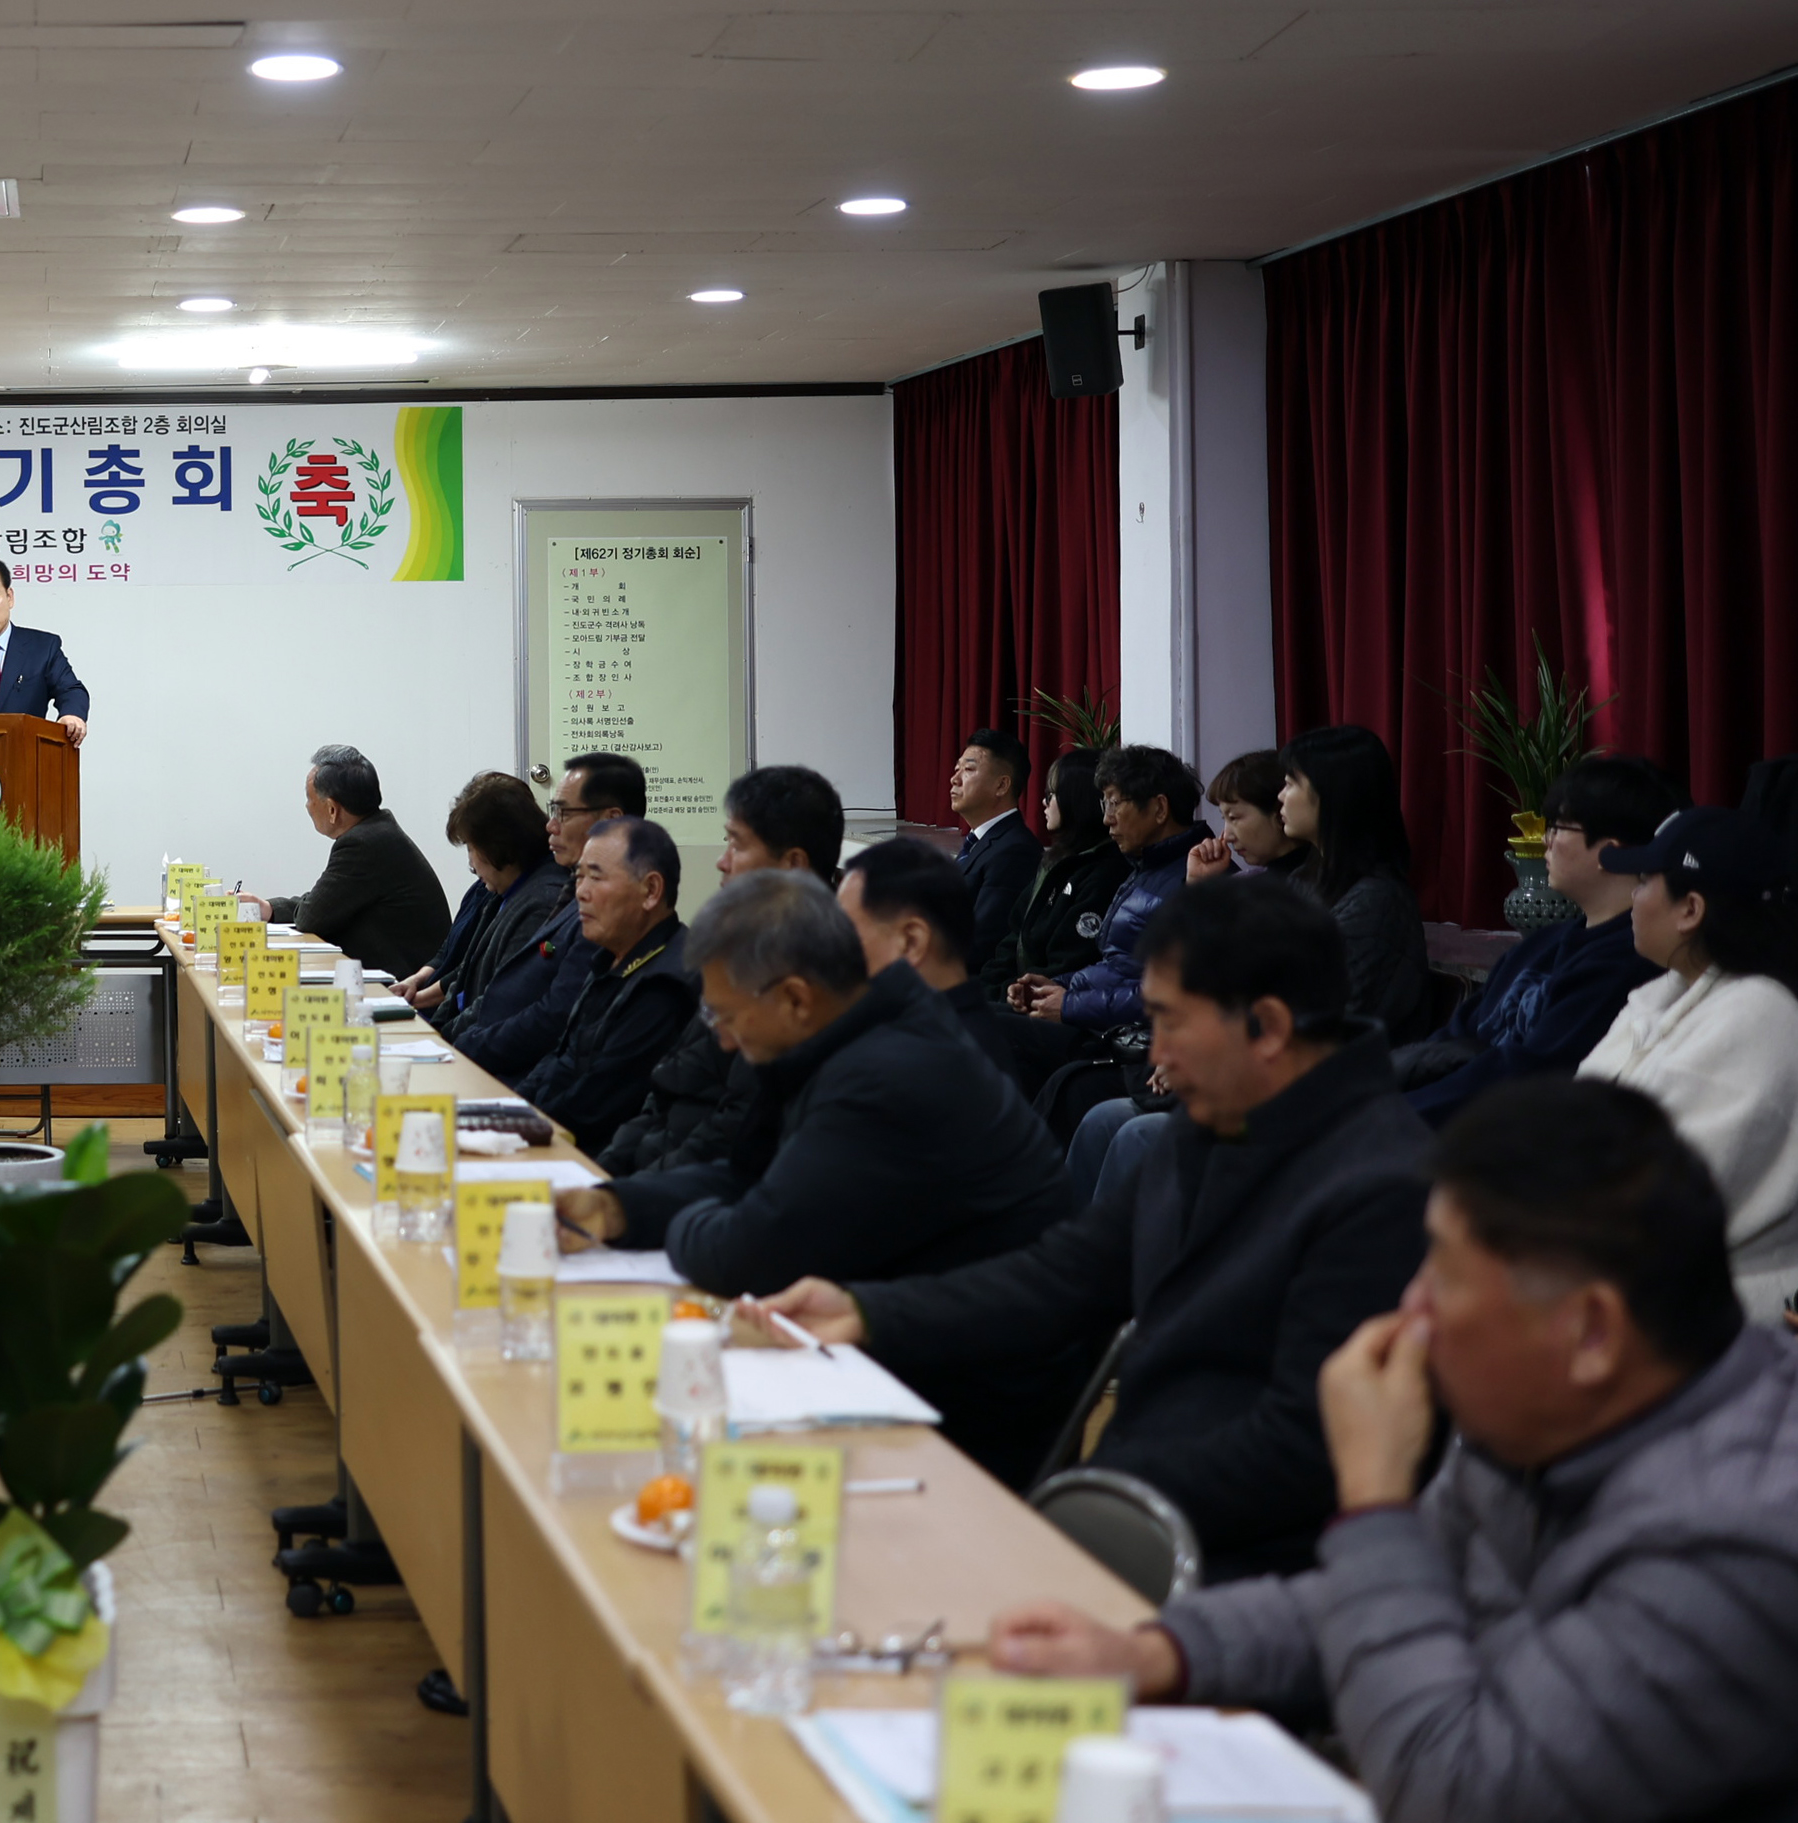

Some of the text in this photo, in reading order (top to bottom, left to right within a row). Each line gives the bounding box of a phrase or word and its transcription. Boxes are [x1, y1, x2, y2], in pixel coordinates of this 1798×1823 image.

[19, 416, 138, 436] 진도군산림조합
[143, 415, 171, 435] 2층
[176, 415, 227, 435] 회의실
[290, 454, 356, 527] 축
[622, 547, 668, 560] 정기총회
[86, 562, 131, 582] 도약
[572, 621, 602, 629] 진도군수
[572, 634, 603, 642] 모아드림
[605, 634, 628, 642] 기부금
